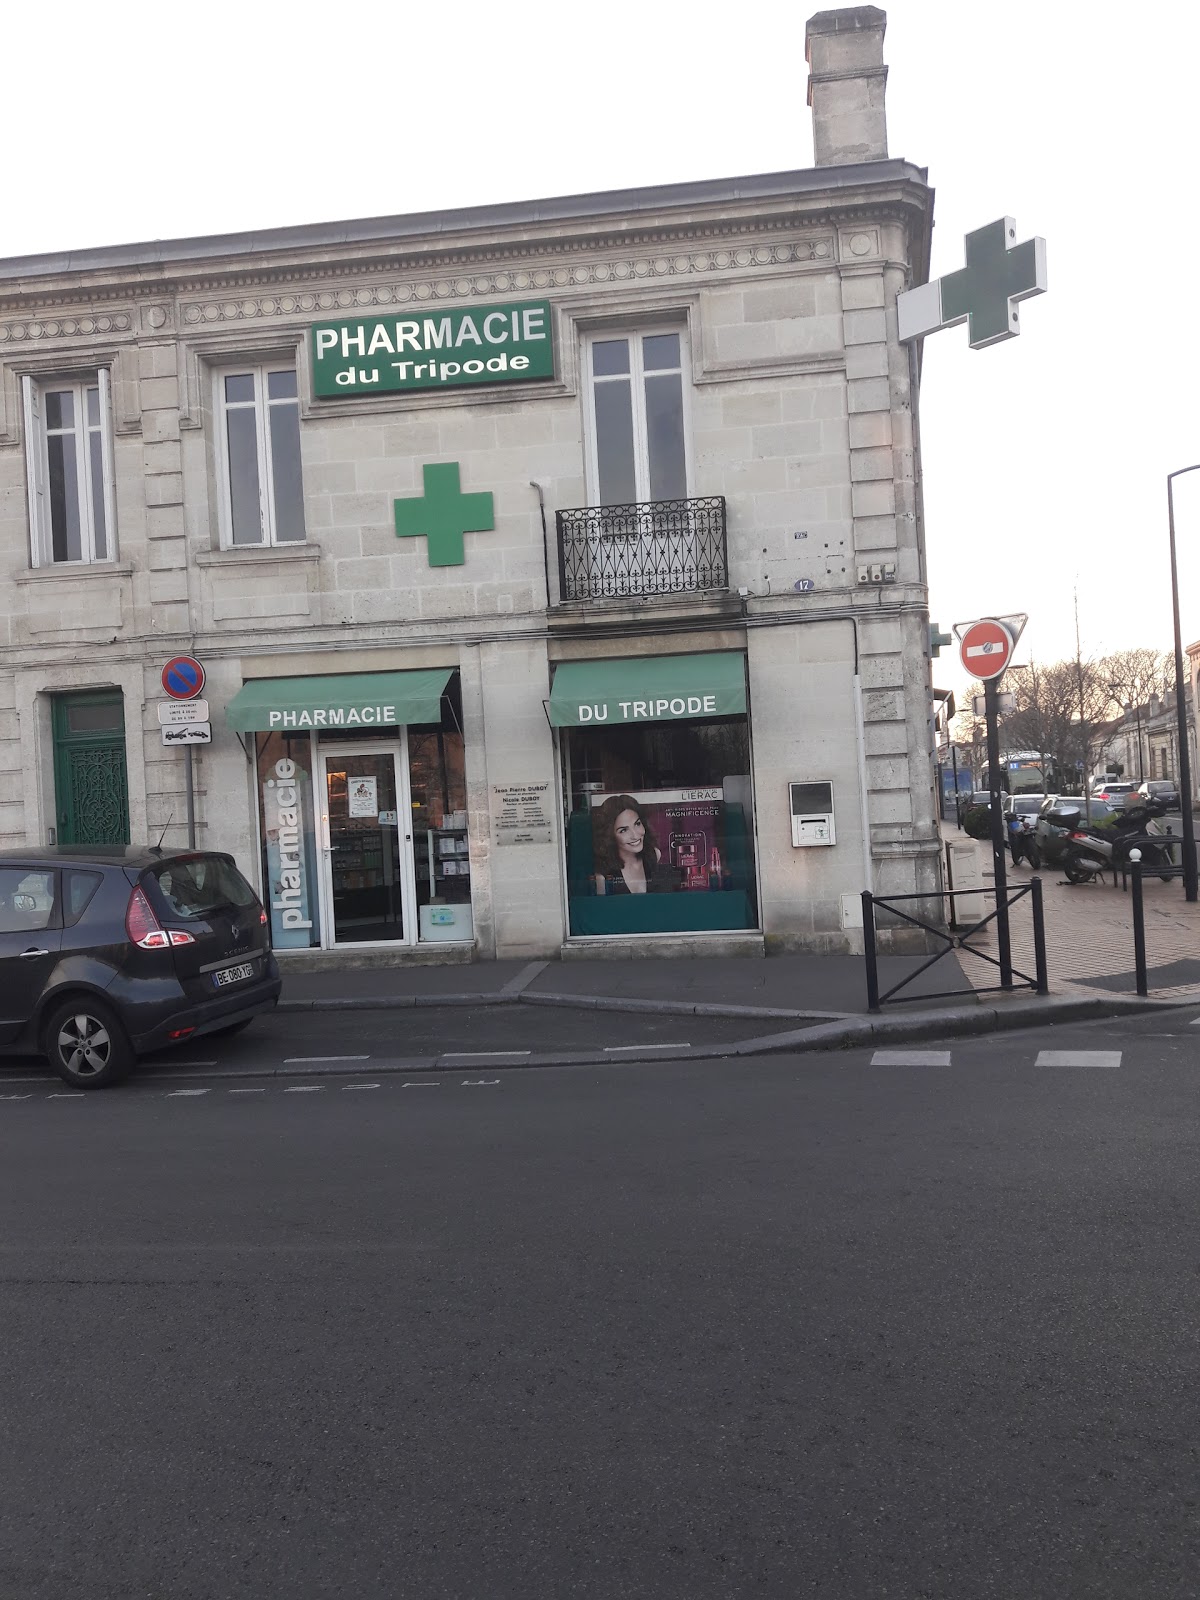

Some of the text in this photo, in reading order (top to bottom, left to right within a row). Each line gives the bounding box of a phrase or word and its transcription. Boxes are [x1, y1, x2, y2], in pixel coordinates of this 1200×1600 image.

[316, 308, 546, 360] PHARMACIE
[335, 352, 530, 385] du Tripode
[269, 706, 396, 727] PHARMACIE
[578, 695, 717, 722] DU TRIPODE
[681, 791, 718, 801] LIERAC
[665, 809, 720, 818] MAGNIFICENCE
[267, 758, 313, 930] pharmacie
